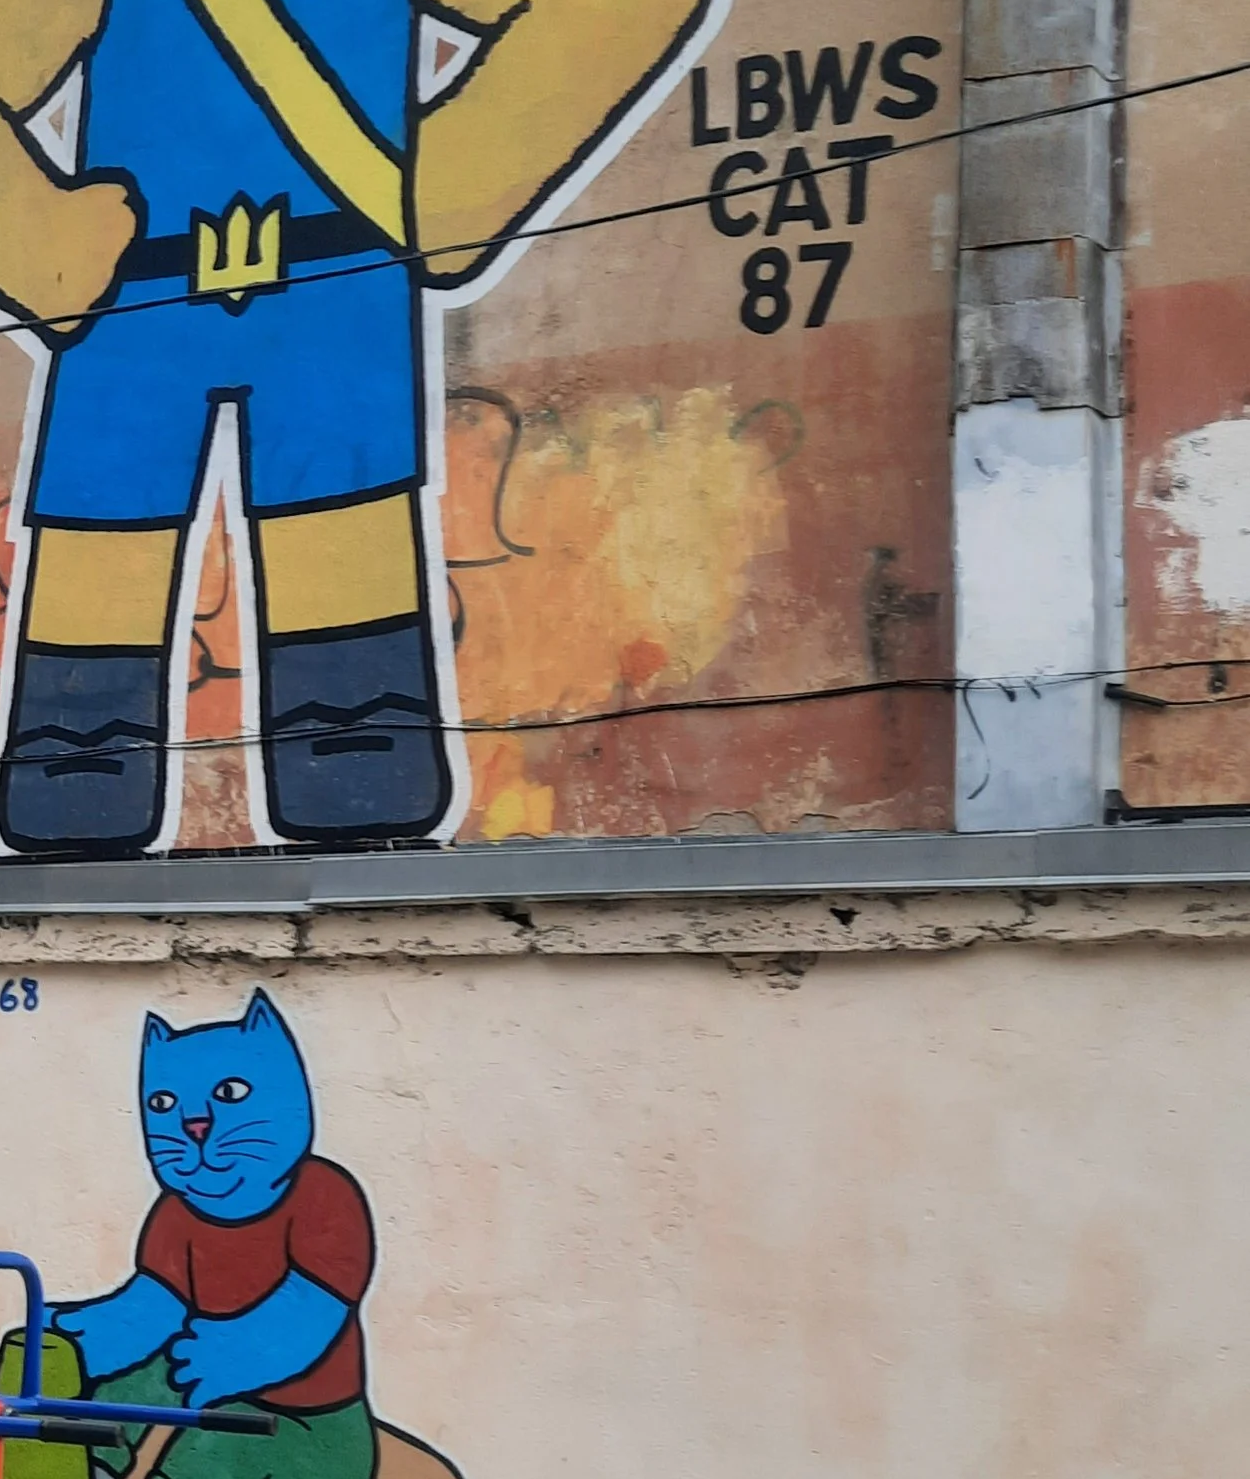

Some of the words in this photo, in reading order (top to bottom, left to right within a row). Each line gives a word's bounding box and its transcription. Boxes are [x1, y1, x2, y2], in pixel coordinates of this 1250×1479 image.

[690, 35, 942, 147] LBWS
[708, 134, 894, 238] CAT
[739, 241, 853, 335] 87
